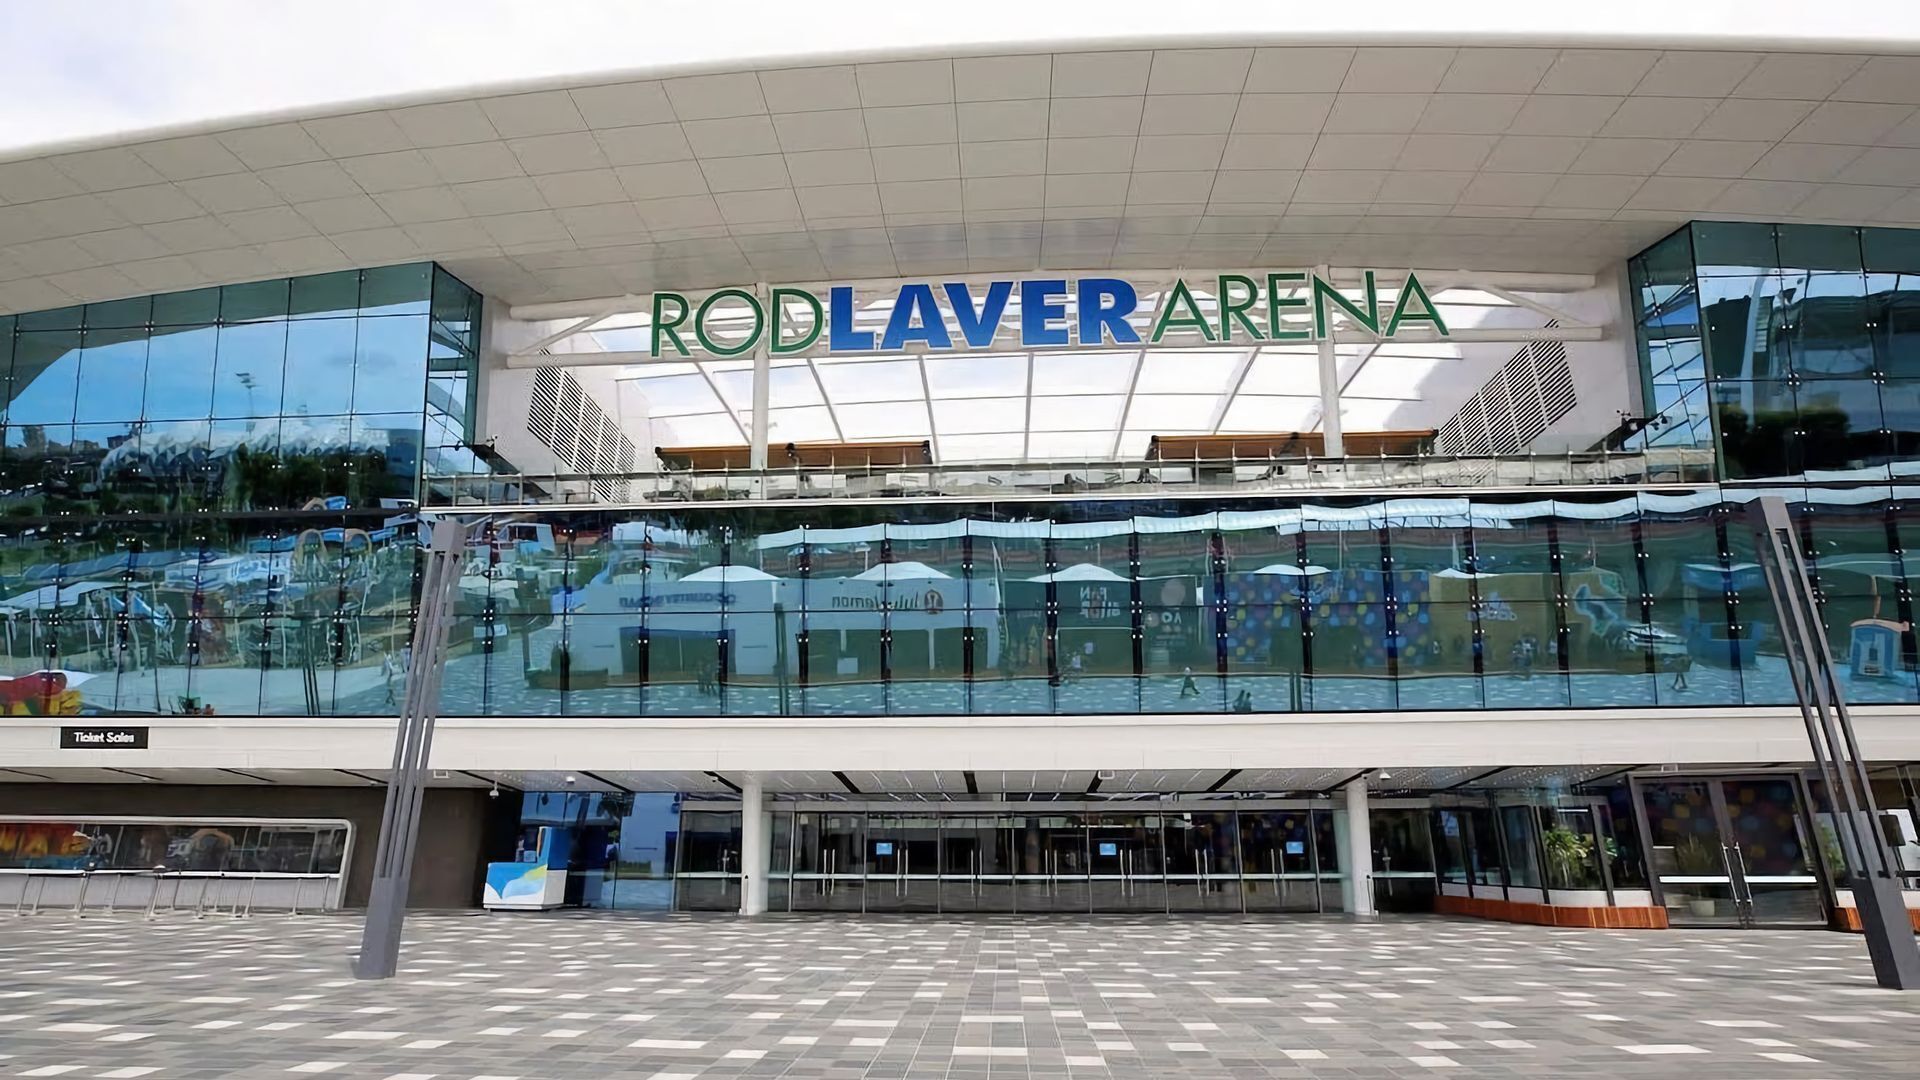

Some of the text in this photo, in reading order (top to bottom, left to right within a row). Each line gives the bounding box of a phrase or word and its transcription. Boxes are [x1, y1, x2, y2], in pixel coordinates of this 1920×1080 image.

[651, 270, 1450, 358] ROD LAVER ARENA
